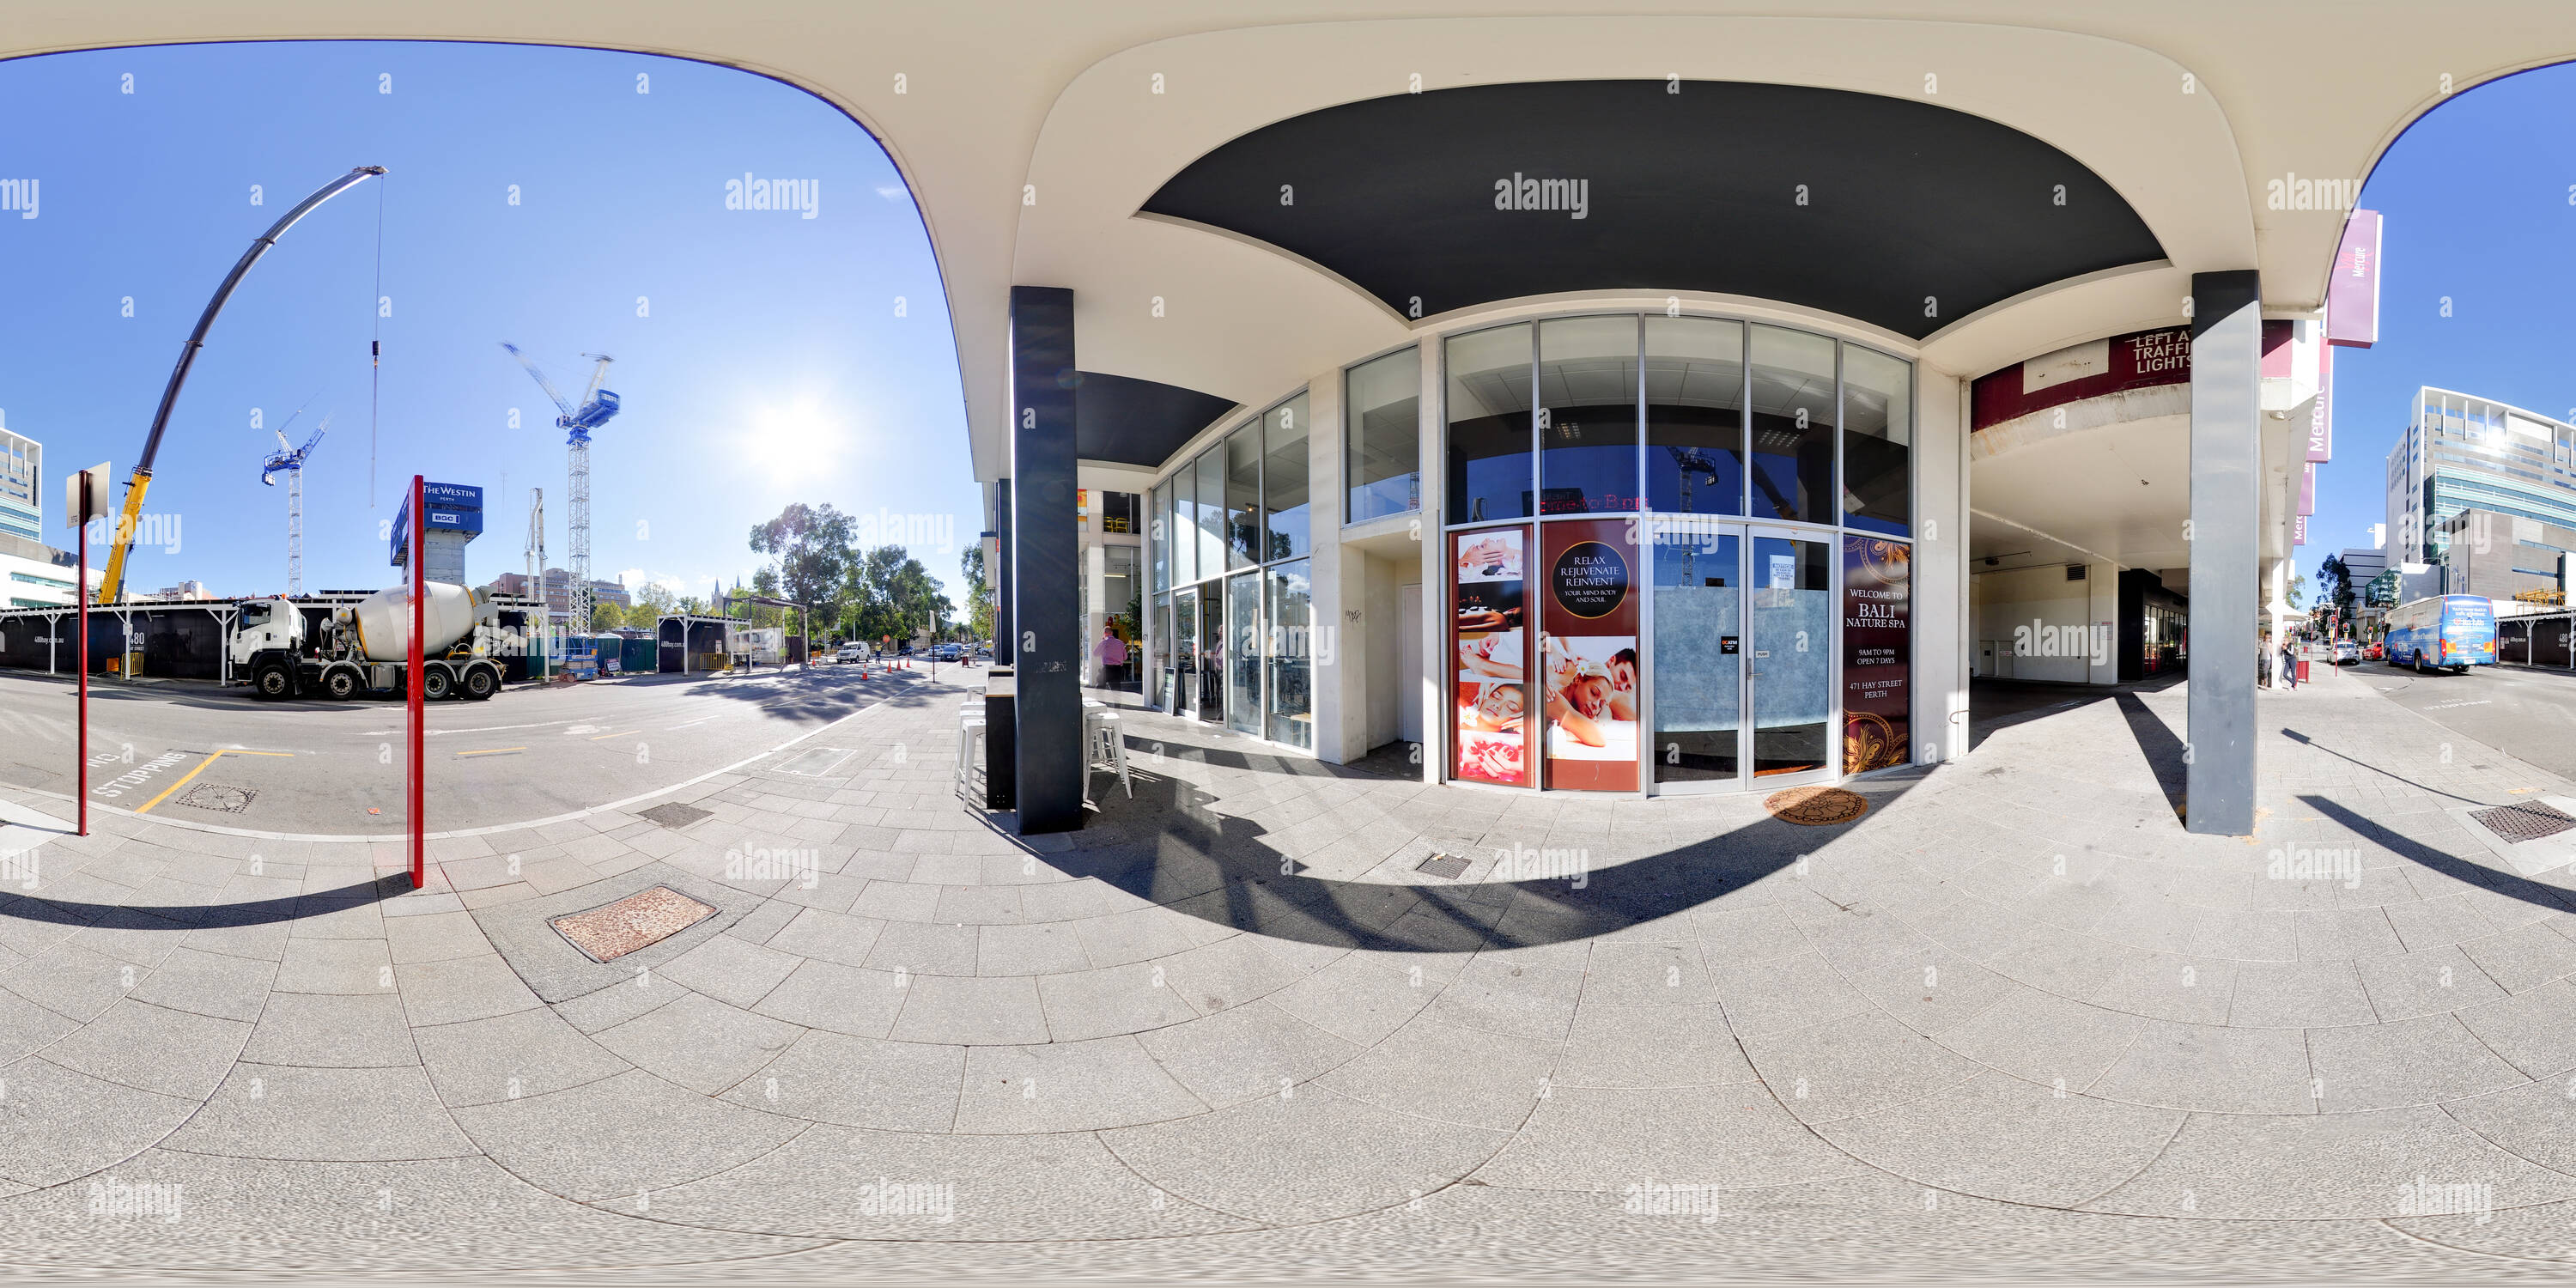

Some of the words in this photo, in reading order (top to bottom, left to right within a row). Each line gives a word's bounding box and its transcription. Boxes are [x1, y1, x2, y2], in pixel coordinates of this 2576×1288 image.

[2353, 246, 2366, 277] Mercure
[2136, 332, 2172, 348] LEFT
[2178, 330, 2191, 342] A
[2133, 343, 2190, 360] TRAFFI
[440, 484, 476, 497] WESTIN
[1575, 556, 1605, 565] RELAX
[1561, 567, 1619, 577] REJUVENATE
[1565, 577, 1614, 586] REINVENT
[1850, 588, 1890, 599] WELCOME
[1893, 592, 1903, 600] TO
[1858, 603, 1895, 618] BALI
[1846, 618, 1887, 628] NATURE
[1889, 619, 1905, 629] SPA
[1862, 681, 1876, 690] HAY
[1878, 679, 1902, 688] STREET
[1865, 690, 1887, 699] PERTH
[91, 753, 187, 797] STOPPING
